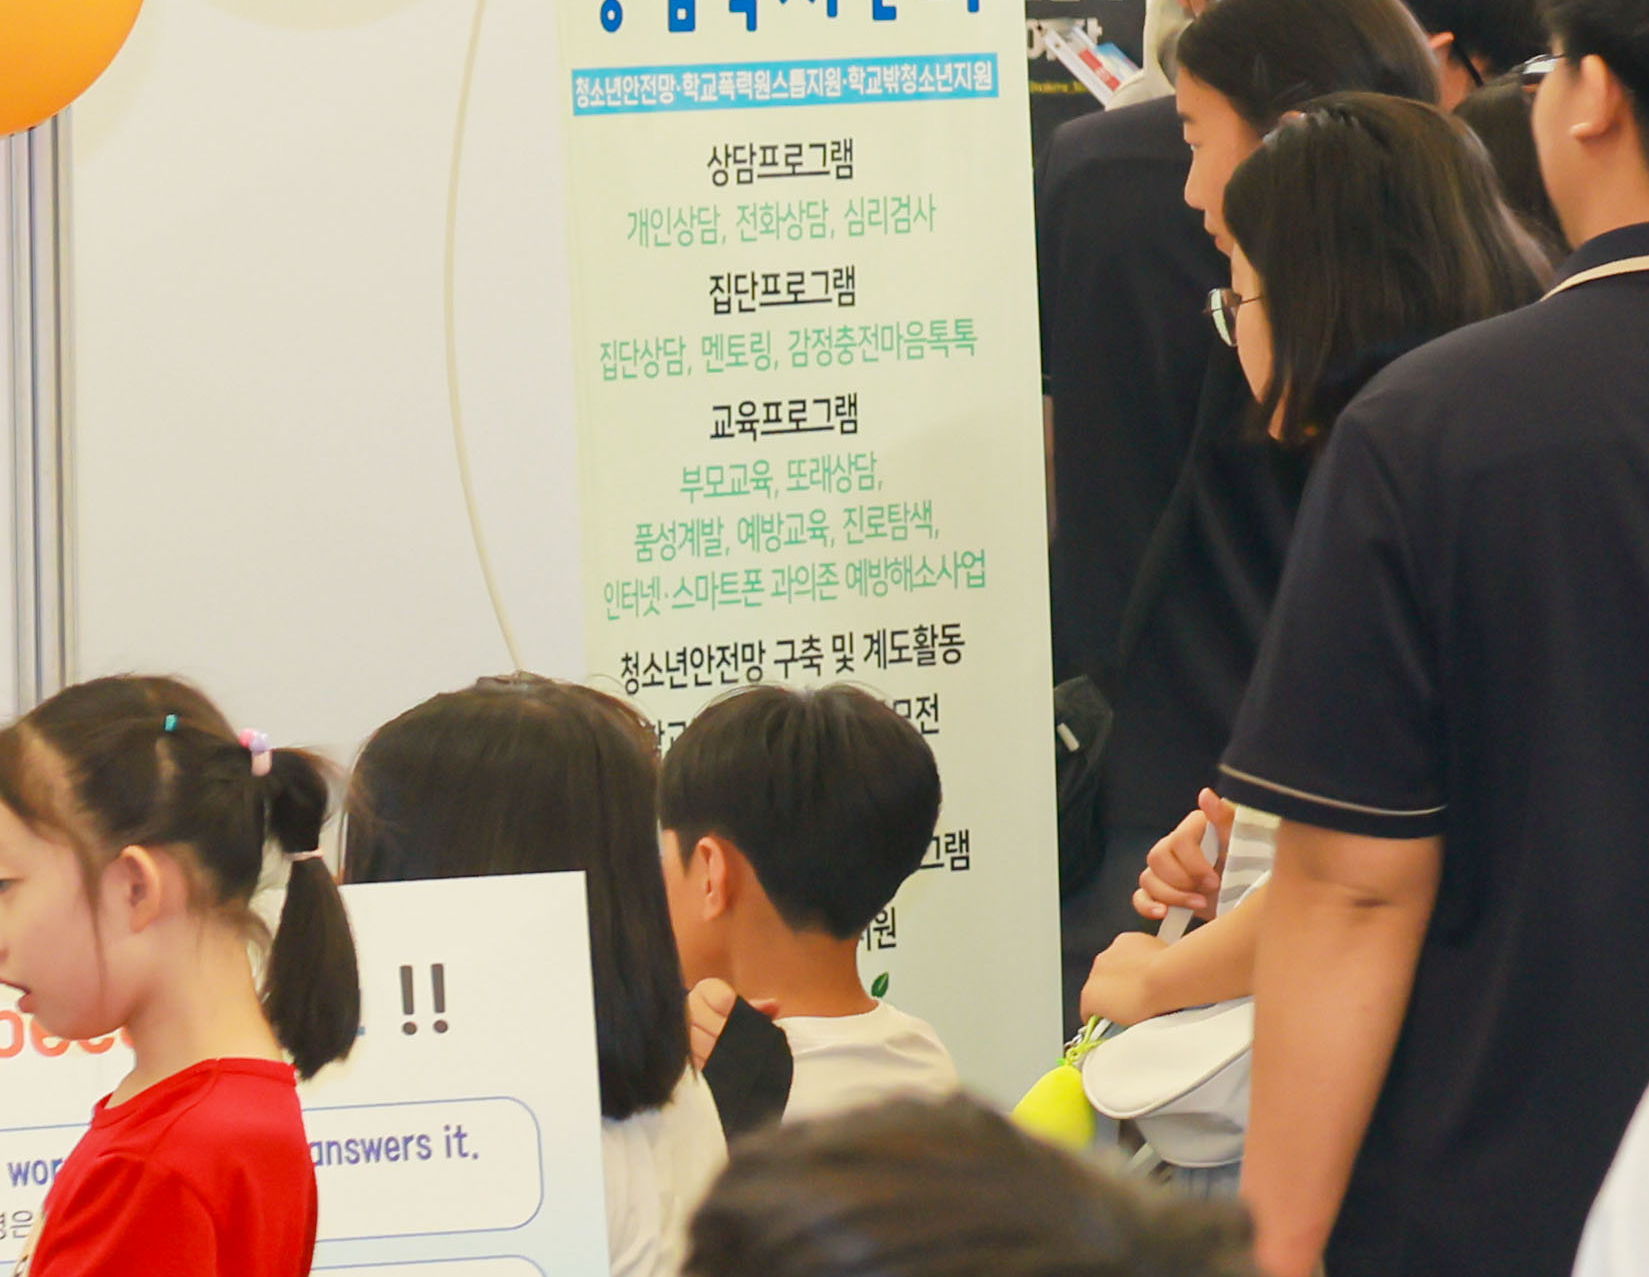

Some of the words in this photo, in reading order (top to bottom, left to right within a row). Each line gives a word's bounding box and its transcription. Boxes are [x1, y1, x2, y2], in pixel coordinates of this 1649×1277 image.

[707, 137, 854, 187] 상담프로그램
[627, 204, 727, 249] 개인상담,
[736, 198, 836, 245] 전화상담,
[843, 193, 937, 238] 심리검사
[708, 264, 857, 317] 집단프로그램
[600, 335, 693, 382] 집단상담,
[700, 330, 780, 374] 멘토링,
[786, 317, 979, 370] 감정충전마음톡톡
[709, 391, 859, 443] 교육프로그램
[680, 457, 780, 505] 부모교육,
[786, 451, 884, 495] 또래상담,
[633, 514, 731, 564] 품성계발,
[736, 507, 837, 555] 예방교육,
[843, 499, 940, 546] 진로탐색,
[770, 561, 839, 603] 과의존
[845, 548, 988, 598] 예방해소사업
[620, 640, 767, 696] 청소년안전망
[773, 634, 825, 678] 구축
[832, 631, 855, 674] 및
[862, 622, 966, 671] 계도활동
[443, 1124, 480, 1161] it.
